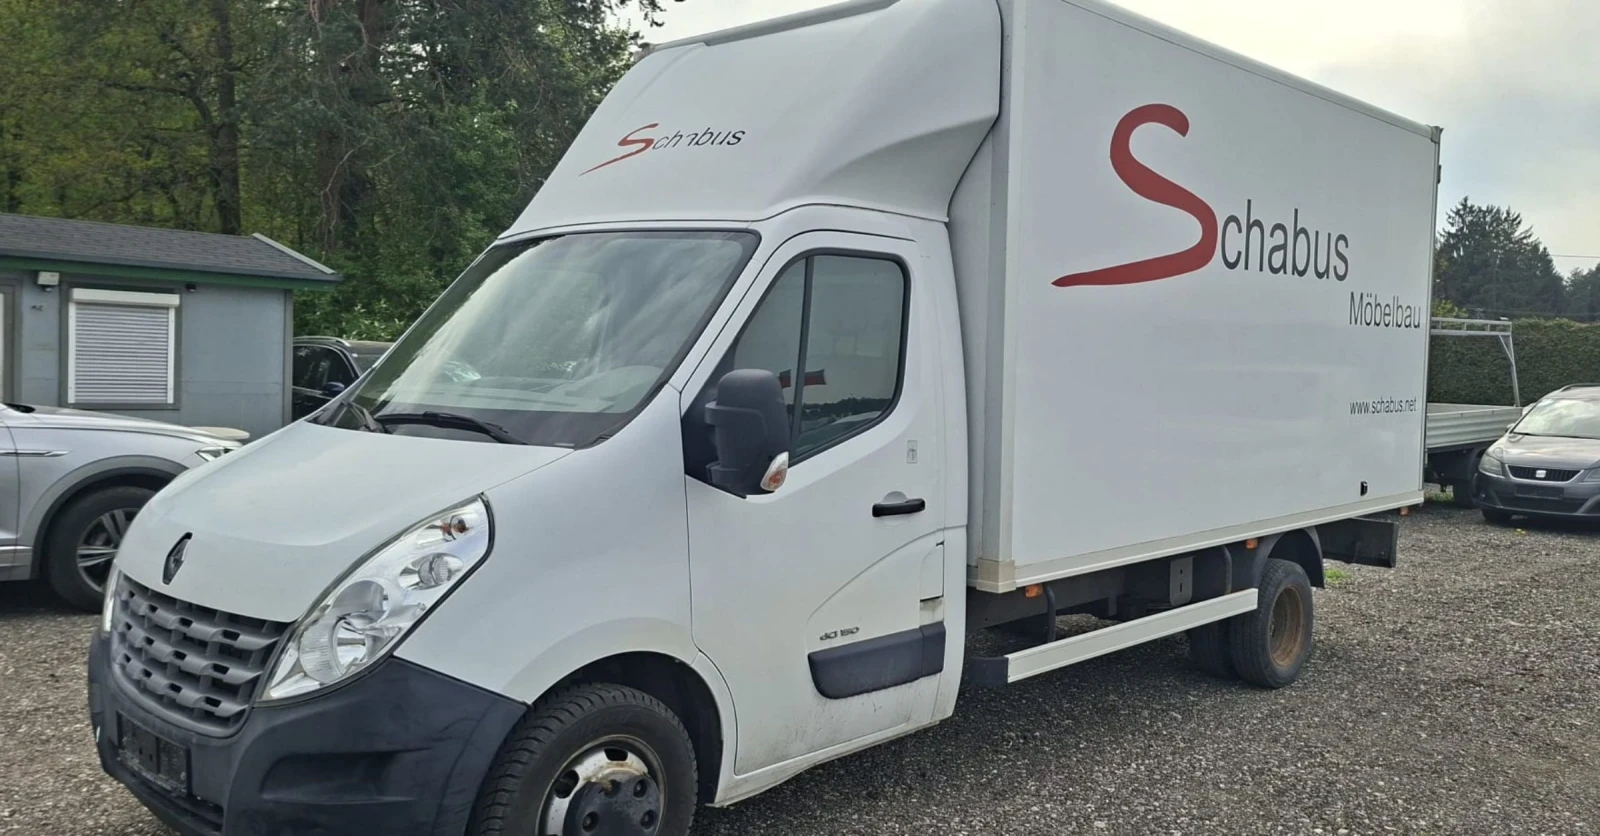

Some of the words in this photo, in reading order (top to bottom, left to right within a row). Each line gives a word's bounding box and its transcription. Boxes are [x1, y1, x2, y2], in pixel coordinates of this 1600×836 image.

[1051, 103, 1350, 287] Schabus
[1349, 291, 1421, 329] Möbelbau
[1349, 396, 1417, 415] www.schabus.net
